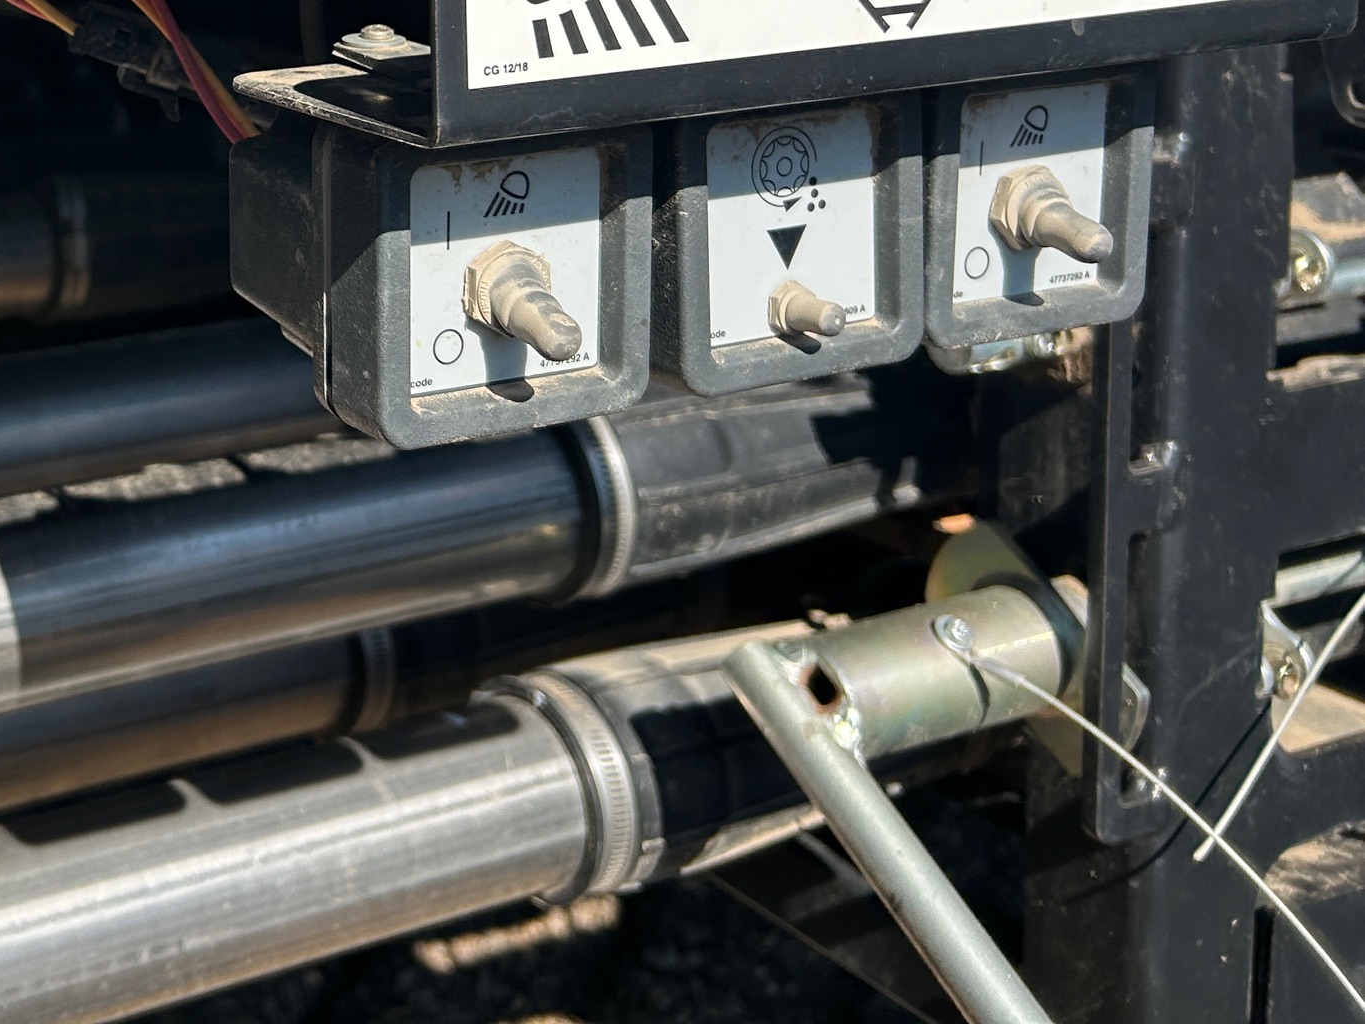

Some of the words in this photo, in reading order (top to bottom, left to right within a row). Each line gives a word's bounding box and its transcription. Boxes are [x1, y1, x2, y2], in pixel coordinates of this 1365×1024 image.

[483, 65, 500, 77] CG
[503, 61, 529, 74] 12/18
[1084, 269, 1090, 278] A
[710, 329, 726, 339] ode
[583, 352, 590, 361] A
[410, 377, 433, 388] code
